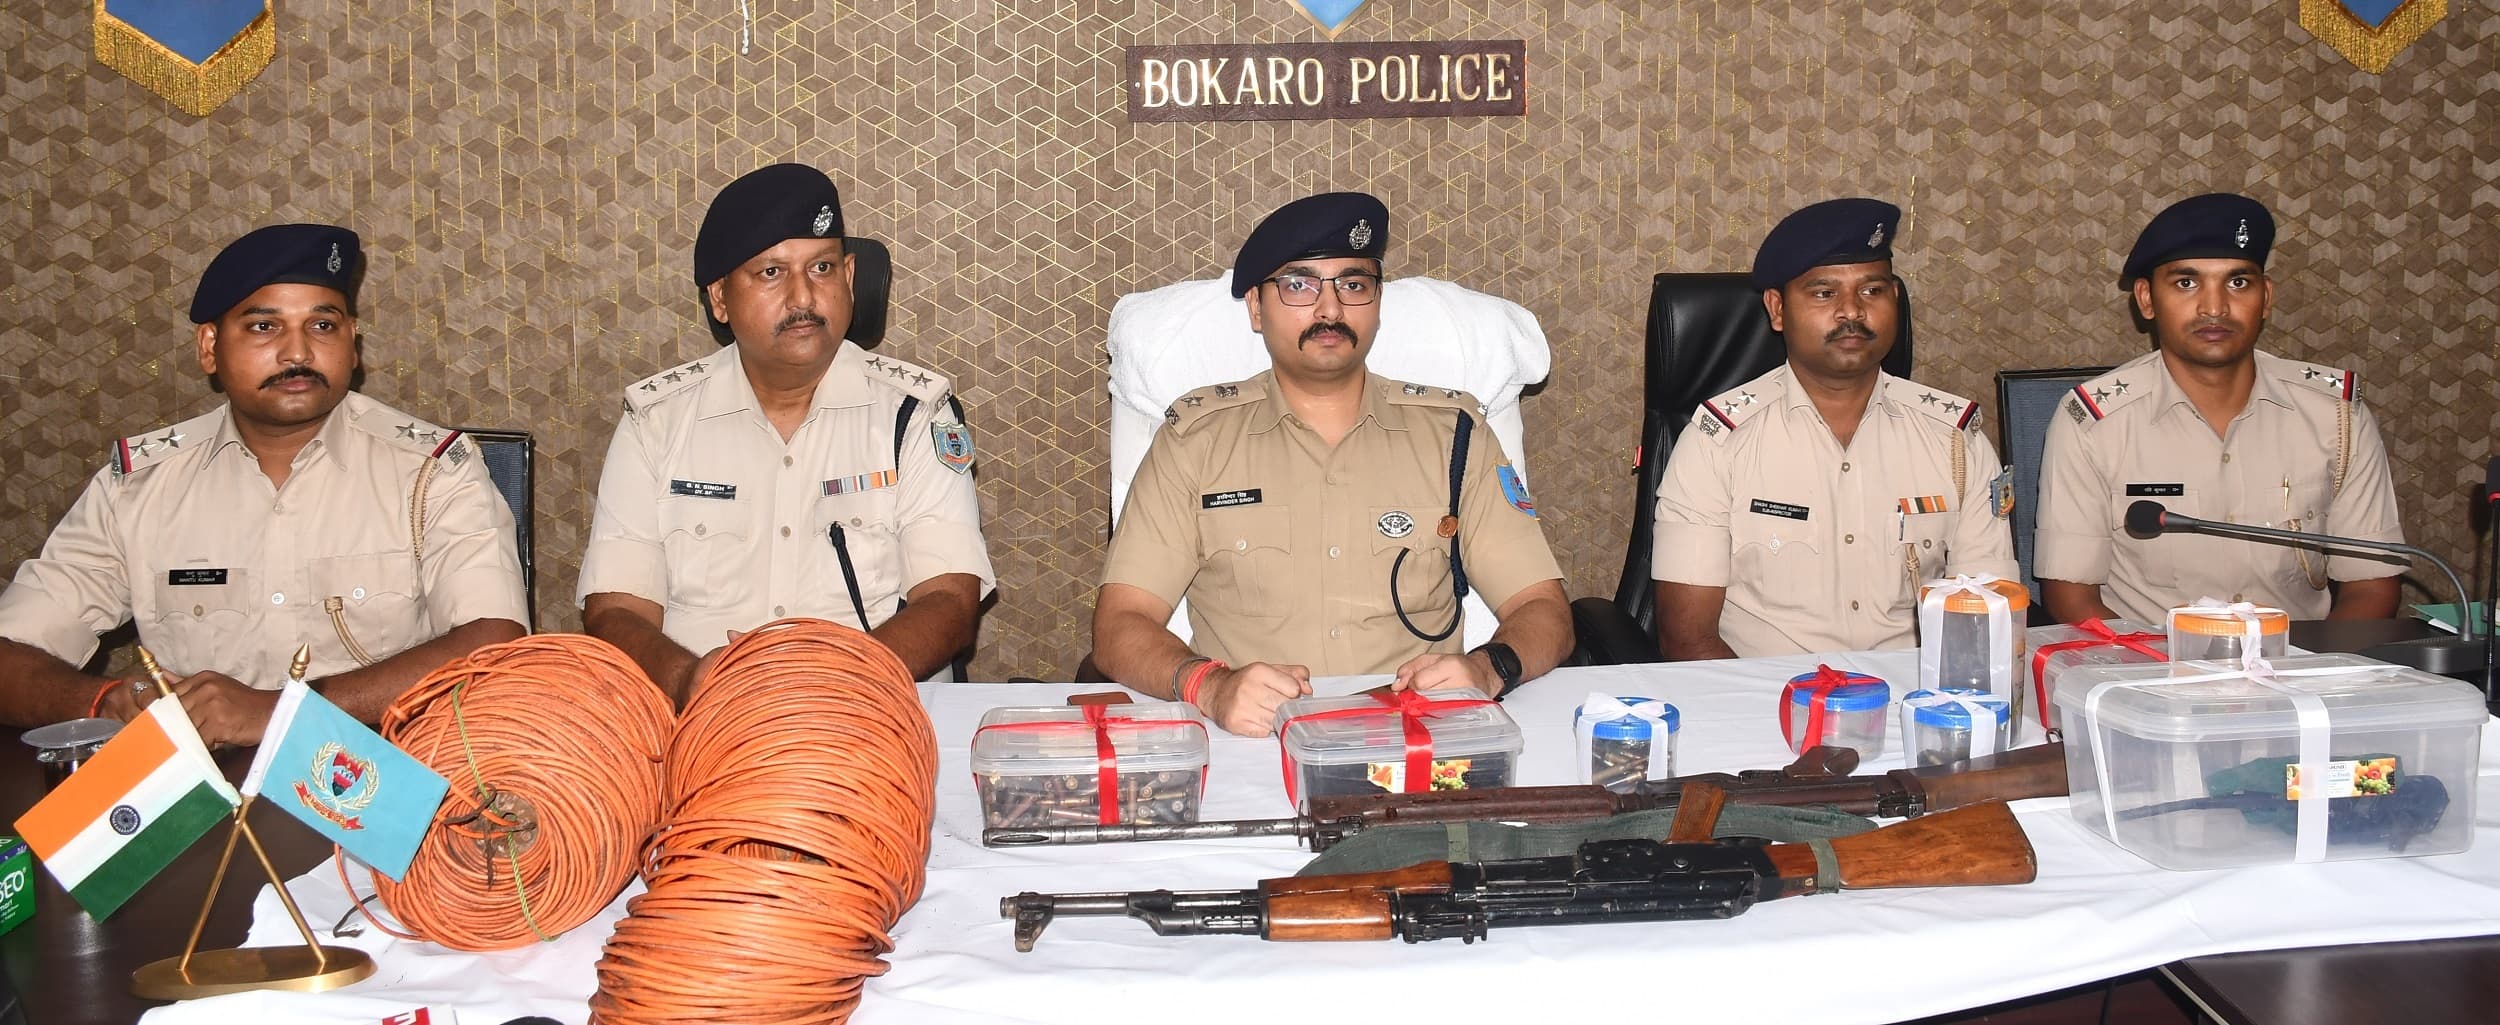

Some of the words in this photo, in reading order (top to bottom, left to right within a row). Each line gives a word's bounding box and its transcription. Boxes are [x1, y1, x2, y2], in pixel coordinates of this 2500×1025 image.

[1143, 57, 1324, 108] BOKARO
[1349, 53, 1512, 105] POLICE
[703, 484, 725, 492] SINGH
[1210, 498, 1239, 506] HARVINDER
[1239, 496, 1255, 504] SINGH
